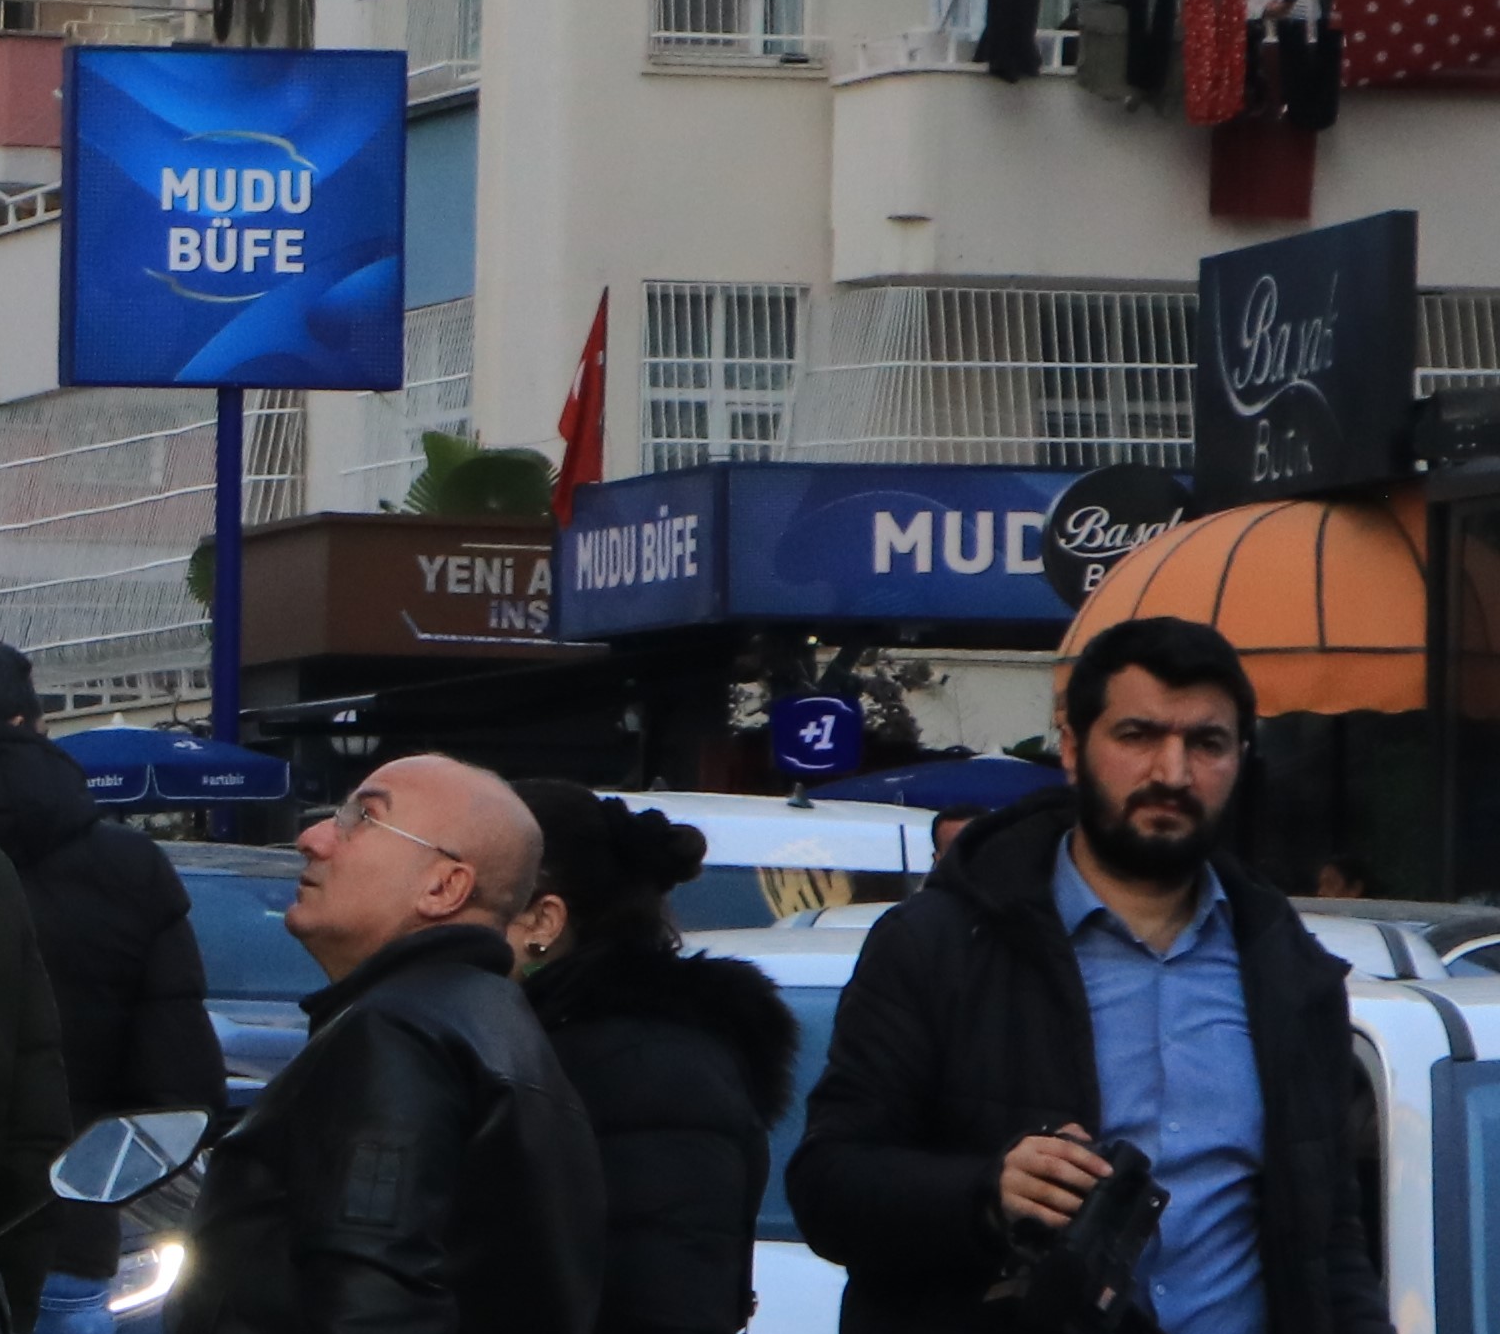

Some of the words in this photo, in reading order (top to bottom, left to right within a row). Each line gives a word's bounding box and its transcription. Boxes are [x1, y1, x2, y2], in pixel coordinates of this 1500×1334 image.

[160, 167, 313, 214] MUDU
[168, 217, 306, 274] BÜFE
[575, 524, 636, 592] MUDU
[642, 505, 698, 584] BÜFE
